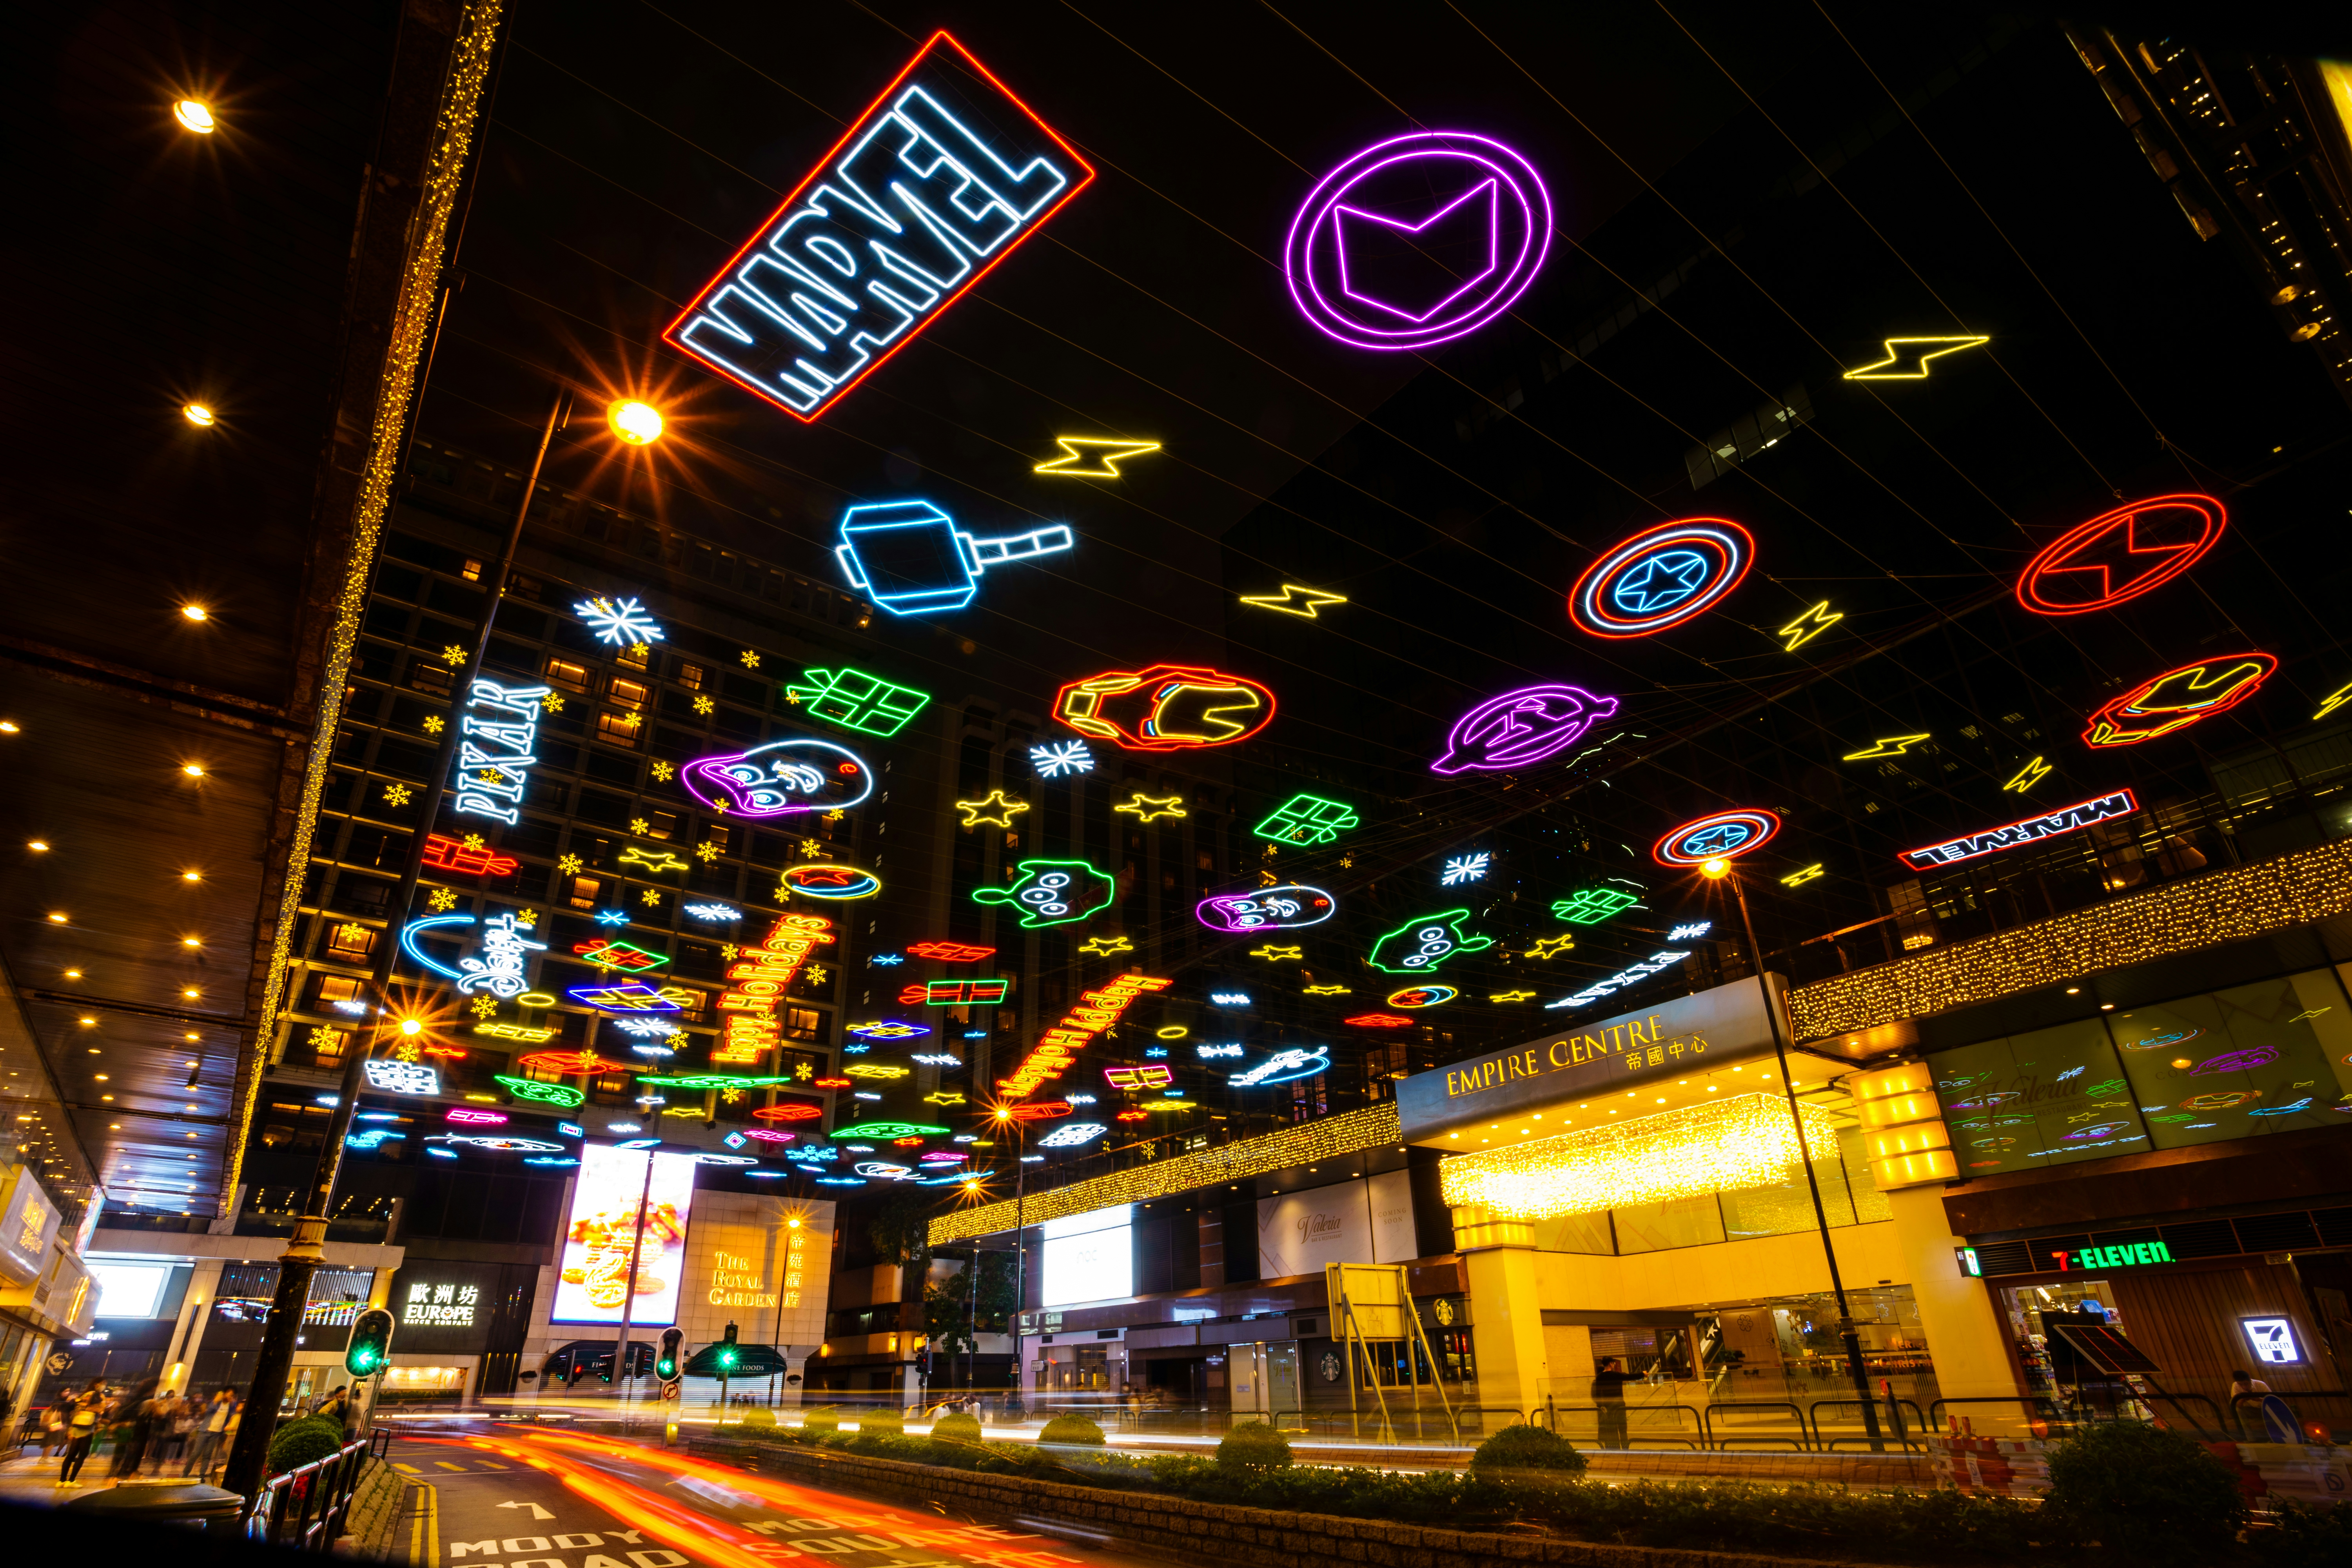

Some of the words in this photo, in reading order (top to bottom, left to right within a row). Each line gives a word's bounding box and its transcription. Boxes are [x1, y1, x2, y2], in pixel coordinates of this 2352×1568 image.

[681, 85, 1067, 411] MARVEL
[456, 679, 552, 825] PIXAR
[1910, 792, 2131, 864] MARVEL
[717, 914, 836, 1012] Holidays
[1544, 951, 1691, 1009] PIXAR
[1060, 974, 1174, 1033] Happy
[710, 1015, 781, 1063] Happy
[1446, 1049, 1539, 1096] EMPIRE
[1549, 1014, 1665, 1067] CENTRE
[1626, 1036, 1708, 1071] 帝國中心
[996, 1028, 1094, 1097] Holidays
[2037, 1102, 2088, 1117] RESTAURANT
[1378, 1207, 1406, 1218] COMING
[1384, 1216, 1403, 1225] SOON
[1688, 1203, 1717, 1213] RESTAURANT
[1297, 1214, 1341, 1244] Valeria
[784, 1234, 806, 1308] 帝苑酒店
[408, 1283, 478, 1305] 歐洲坊
[405, 1304, 474, 1320] EUROPE
[432, 1372, 455, 1388] 40
[740, 1513, 916, 1534] MODY
[450, 1530, 644, 1557] MODY
[452, 1550, 690, 1568] OAD
[739, 1524, 1044, 1559] SQUARE
